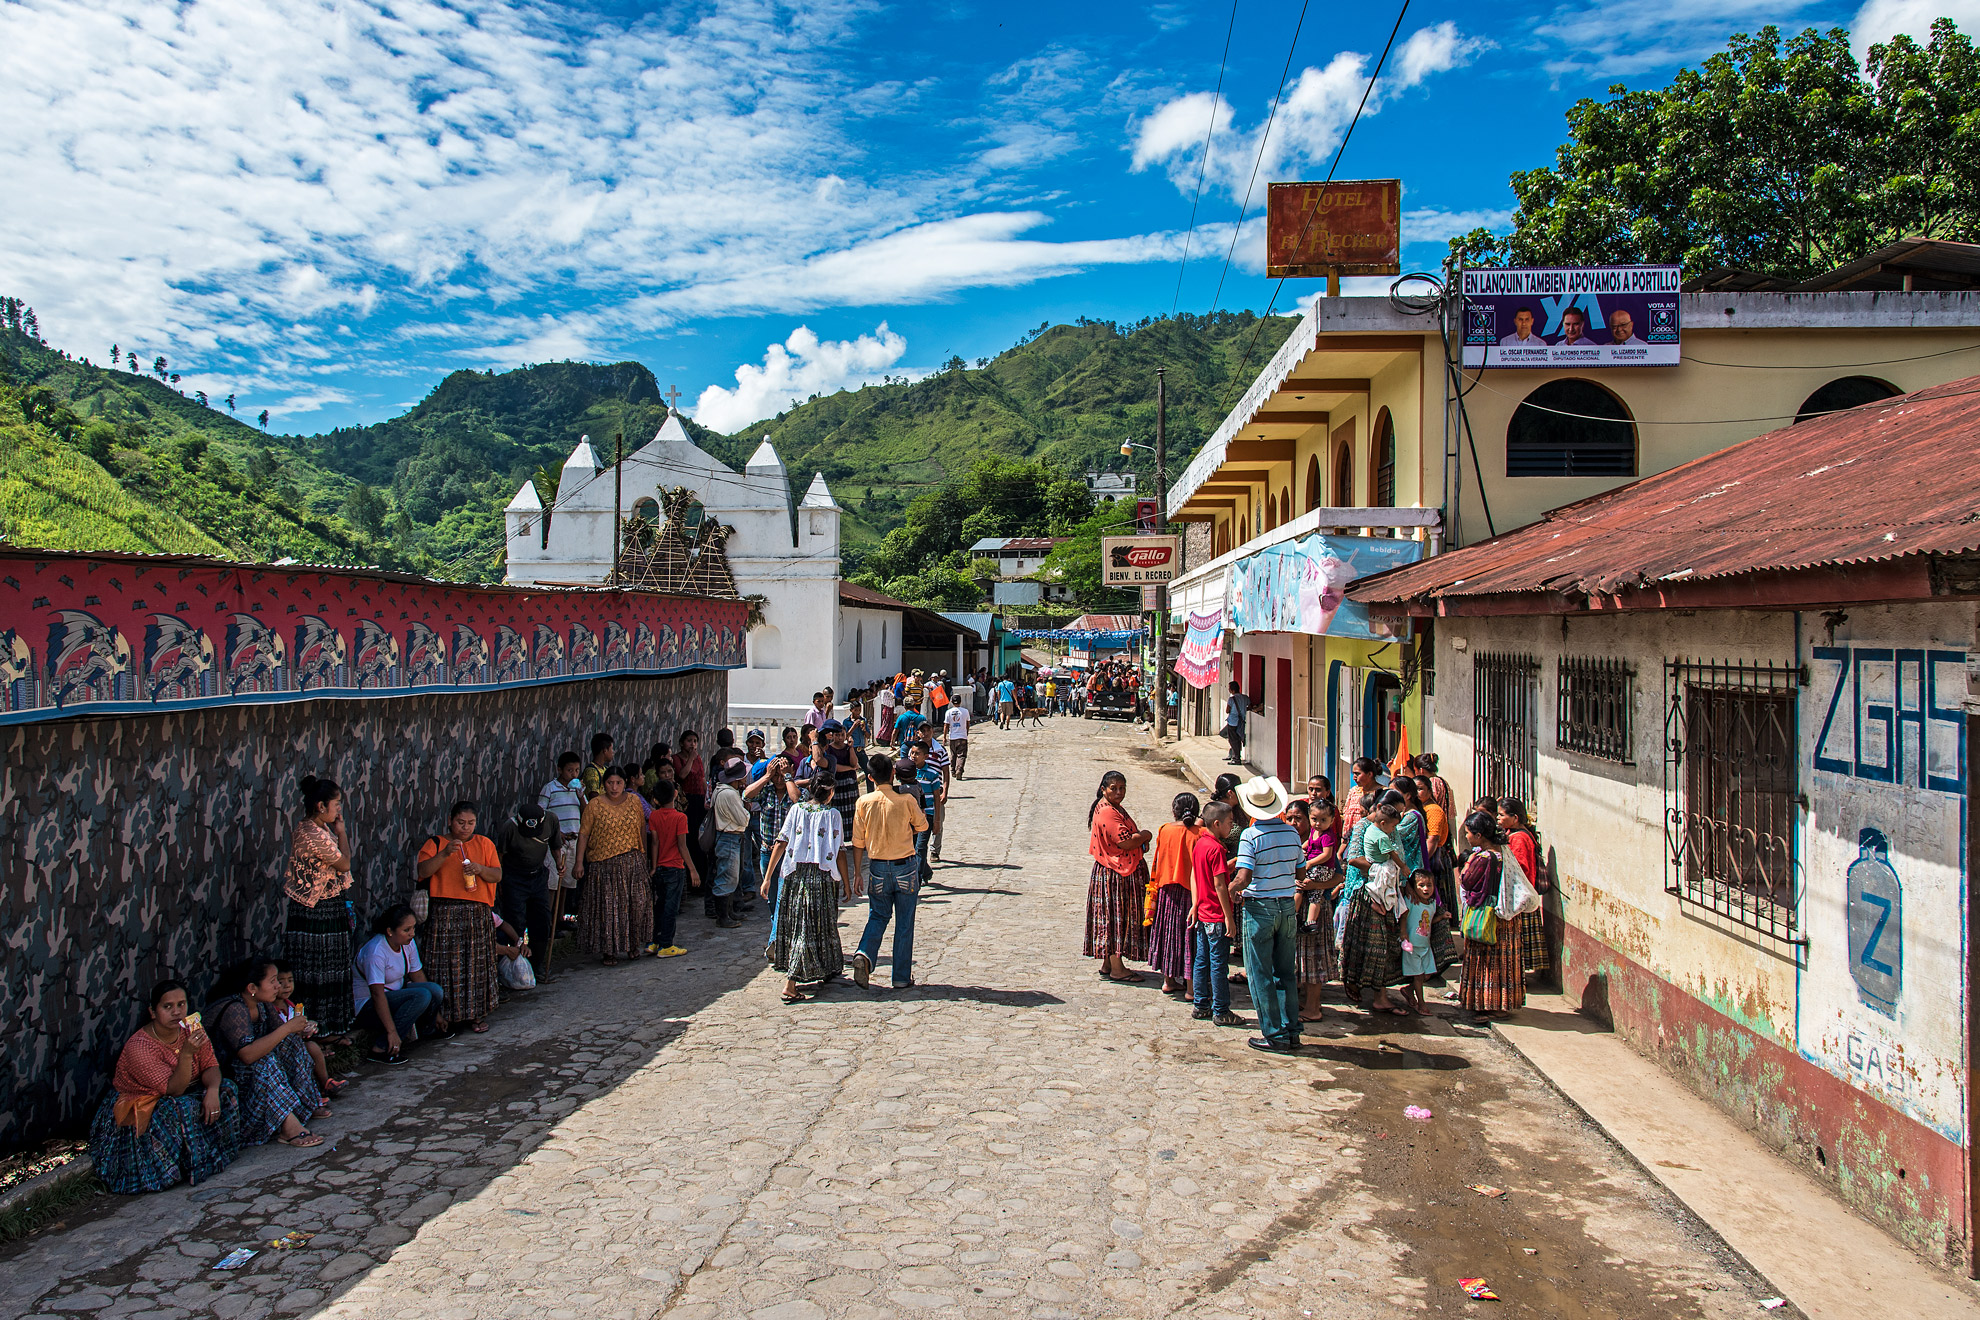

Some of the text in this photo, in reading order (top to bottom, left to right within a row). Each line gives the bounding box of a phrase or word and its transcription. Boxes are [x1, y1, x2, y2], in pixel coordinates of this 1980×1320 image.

[1465, 270, 1678, 295] EN LANQUIN TAMBIEN APOYAMOS A PORTILLO
[1127, 549, 1166, 563] Gallo
[1369, 546, 1400, 554] Bebidas
[1110, 570, 1172, 580] BIENV. EL RECREO
[1813, 647, 1966, 793] ZGAS
[1860, 892, 1893, 977] Z
[1846, 1035, 1910, 1091] GAS
